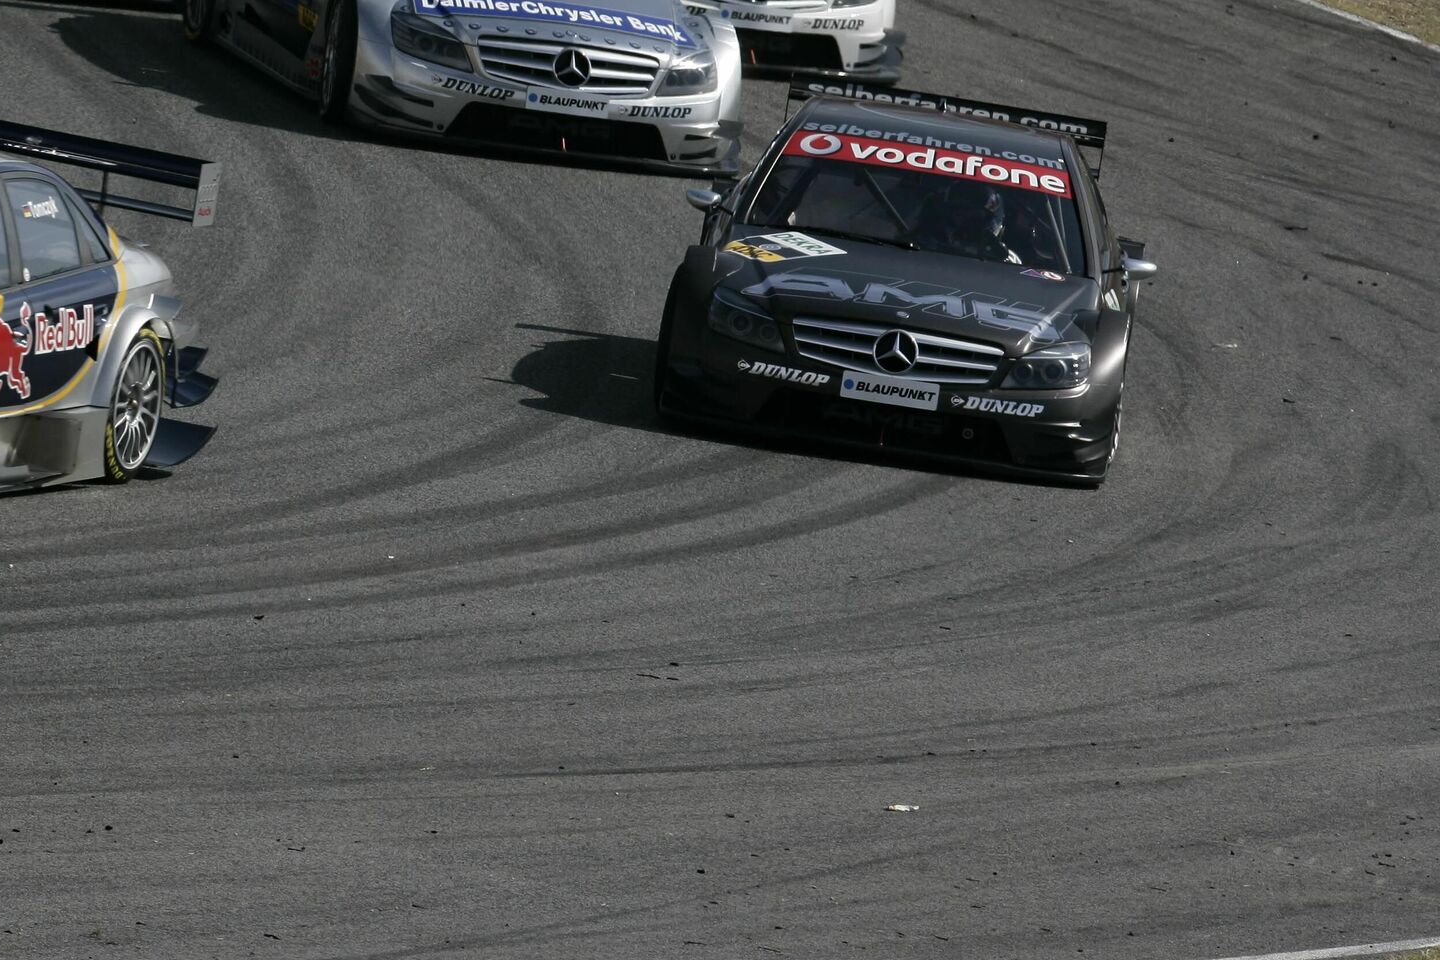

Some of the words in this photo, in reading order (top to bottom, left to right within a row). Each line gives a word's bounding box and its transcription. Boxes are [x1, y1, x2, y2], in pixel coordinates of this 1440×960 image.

[626, 15, 687, 44] Bank
[730, 10, 792, 26] BLAUPUNKT
[811, 18, 865, 32] DUNLOP
[441, 76, 516, 101] DUNLOP
[539, 94, 608, 113] BLAUPUNKT
[627, 104, 692, 120] DUNLOP
[802, 120, 1066, 170] selberfahren.com
[849, 142, 1066, 194] vodafone
[771, 232, 834, 255] DEKRA
[741, 270, 1070, 343] AMG
[34, 307, 65, 355] Red
[64, 303, 95, 351] Bull
[747, 360, 831, 388] DUNLOP
[855, 380, 938, 404] BLAUPUNKT
[963, 395, 1046, 419] DUNLOP
